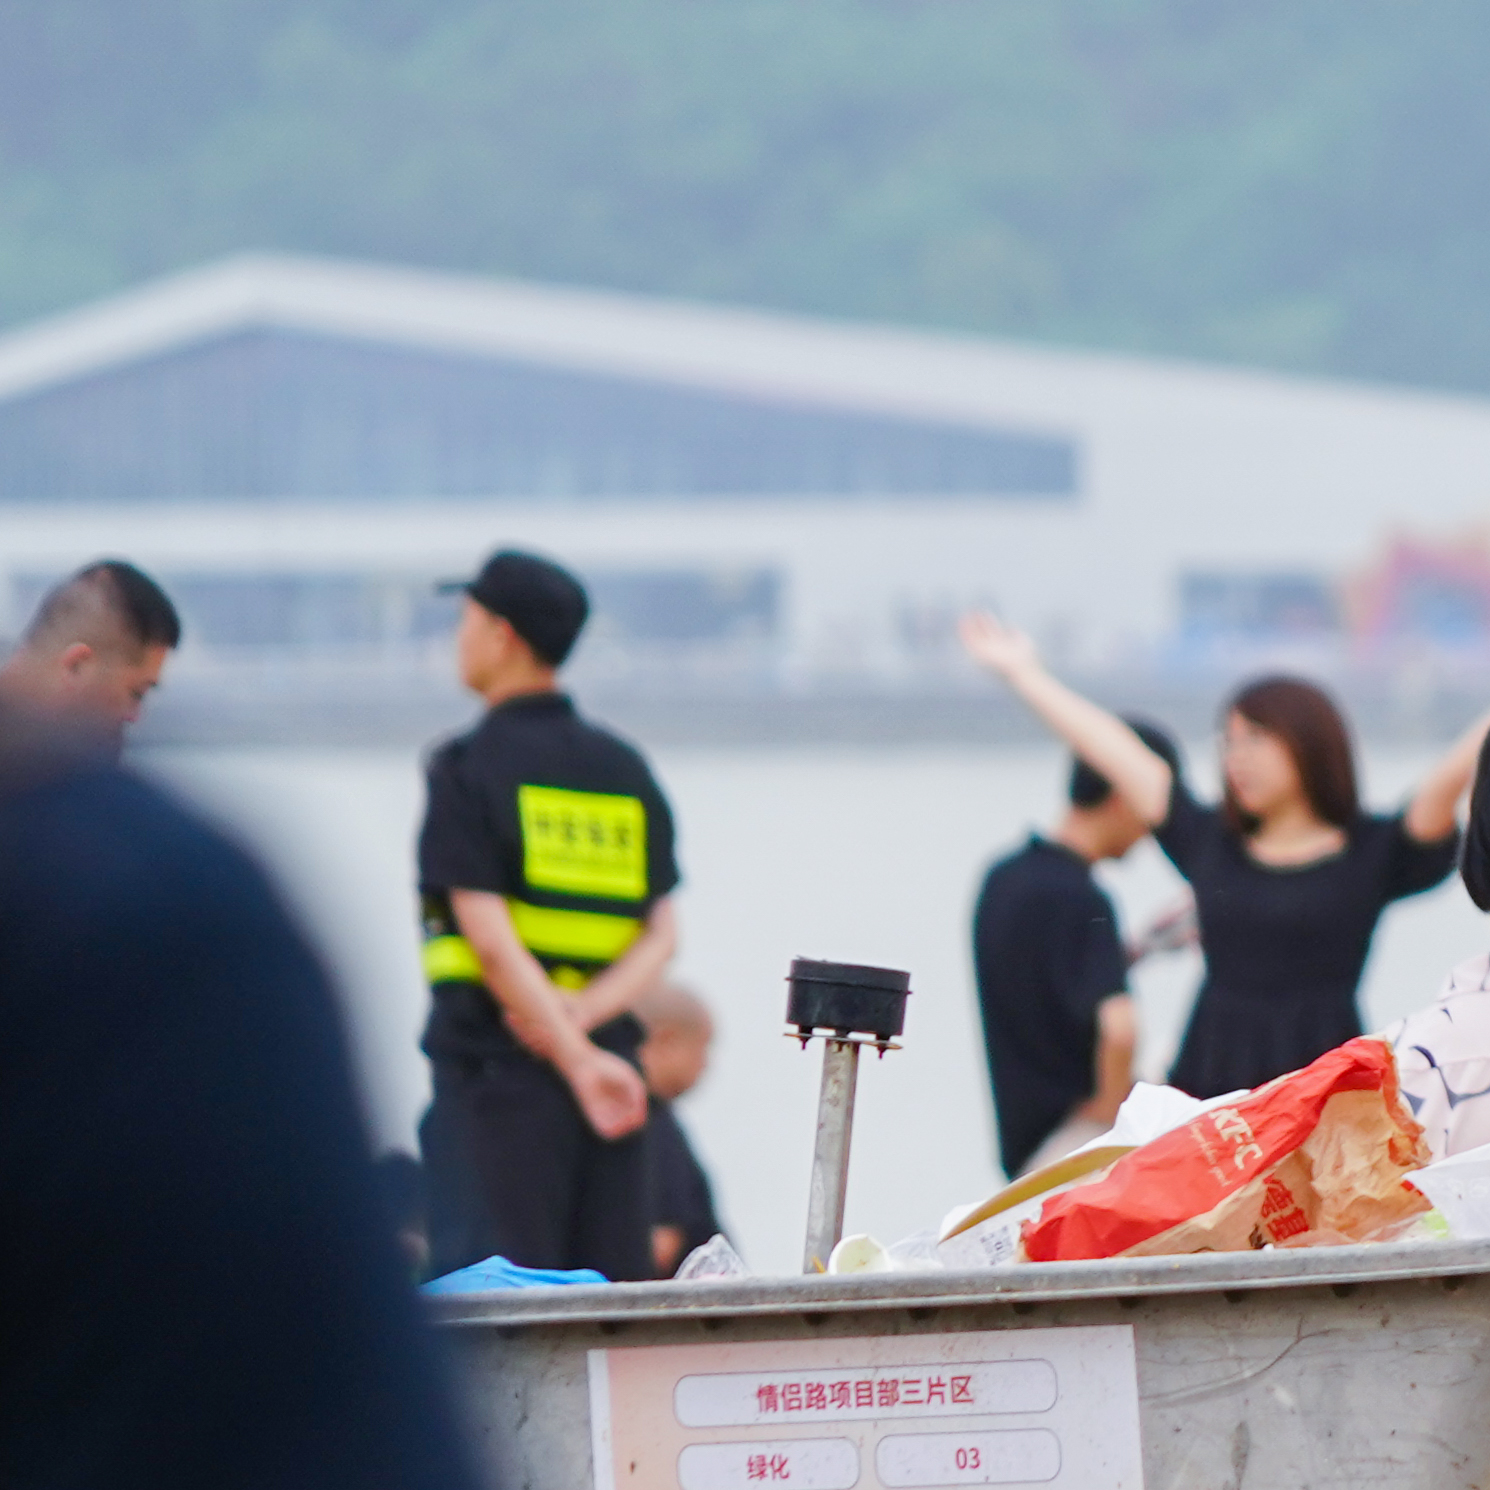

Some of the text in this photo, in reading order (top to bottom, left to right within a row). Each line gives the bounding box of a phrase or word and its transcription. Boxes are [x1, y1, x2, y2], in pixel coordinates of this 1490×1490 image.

[1208, 1108, 1263, 1170] KFC
[756, 1374, 974, 1414] 情侣路项目部三片区
[747, 1454, 790, 1481] 绿化
[955, 1447, 981, 1470] 03
